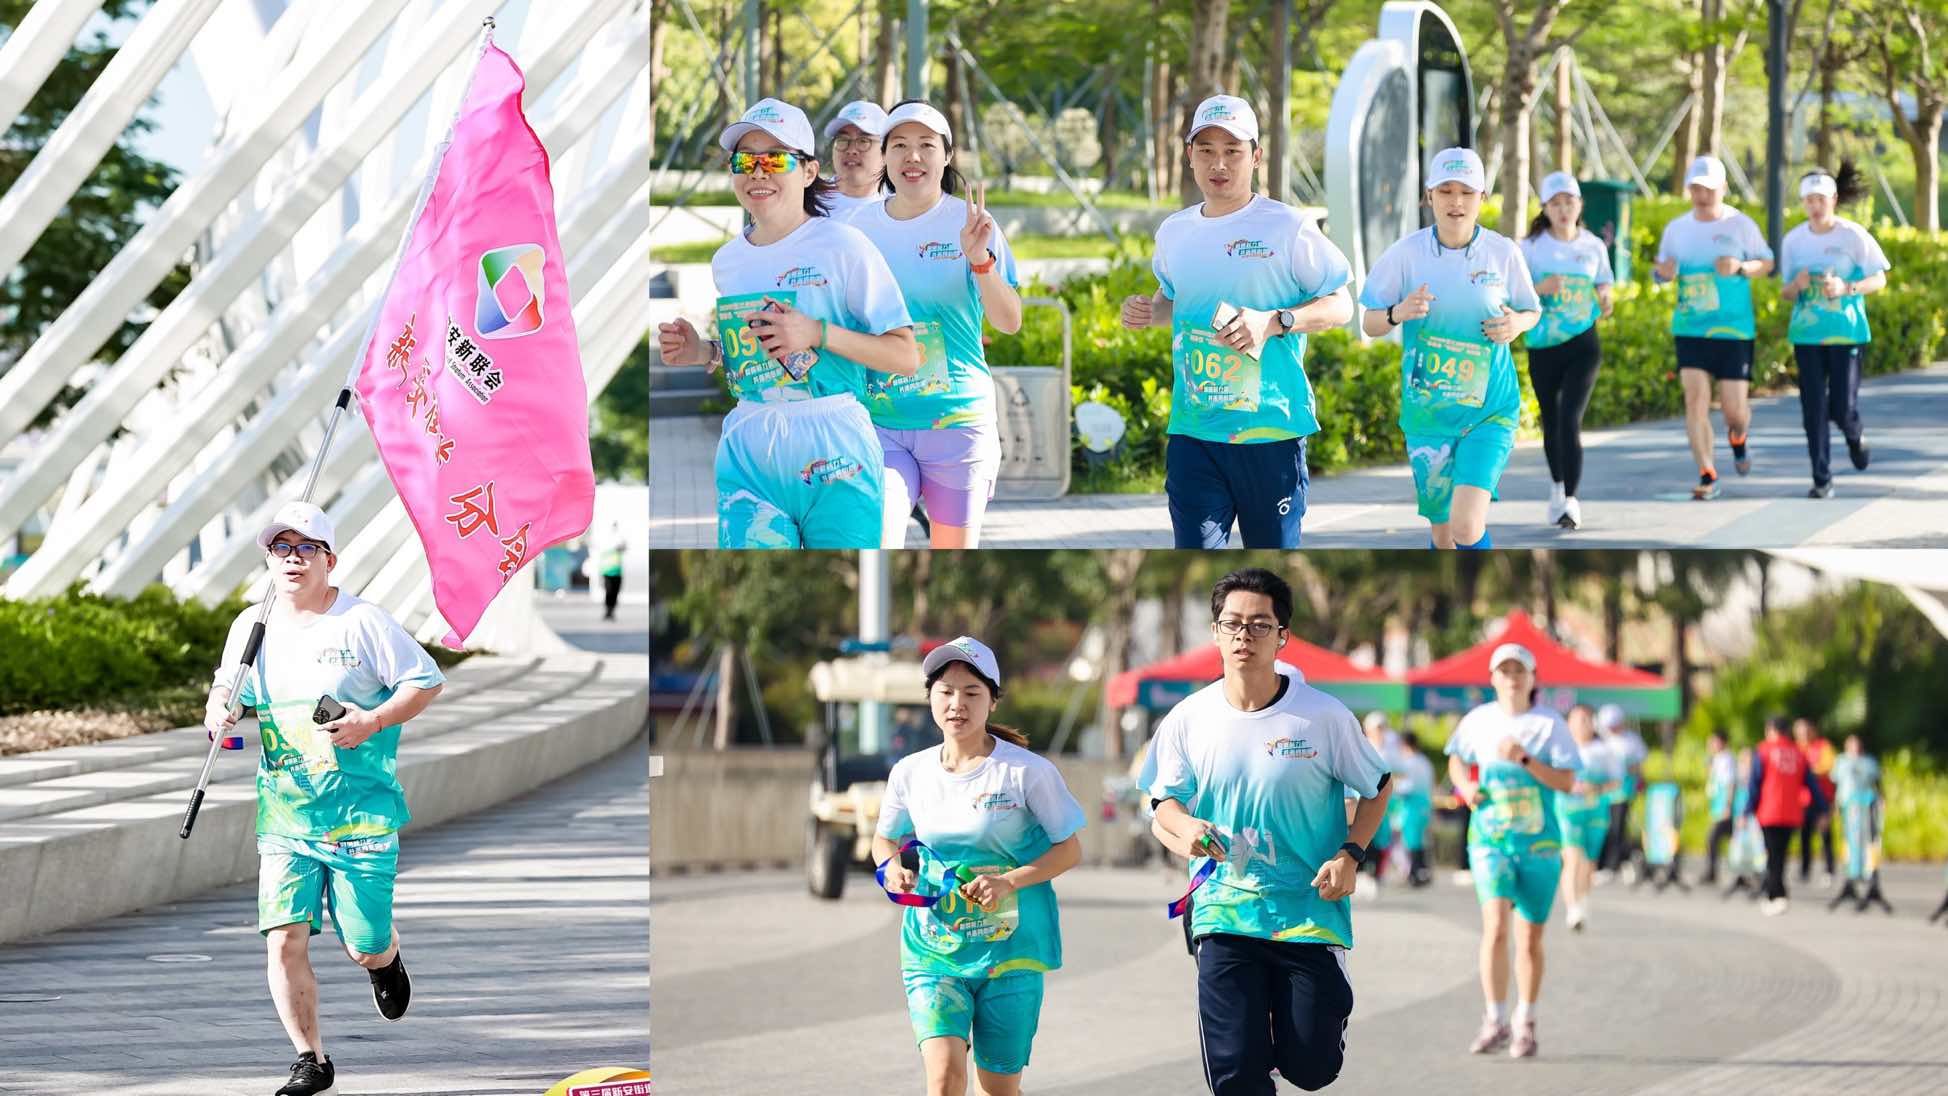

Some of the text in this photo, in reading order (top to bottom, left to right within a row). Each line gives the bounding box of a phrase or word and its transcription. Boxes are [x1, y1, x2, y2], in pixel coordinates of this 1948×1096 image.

[448, 315, 502, 390] 安新联会
[1191, 349, 1242, 382] 062
[1426, 352, 1474, 382] 049
[465, 378, 489, 402] Association
